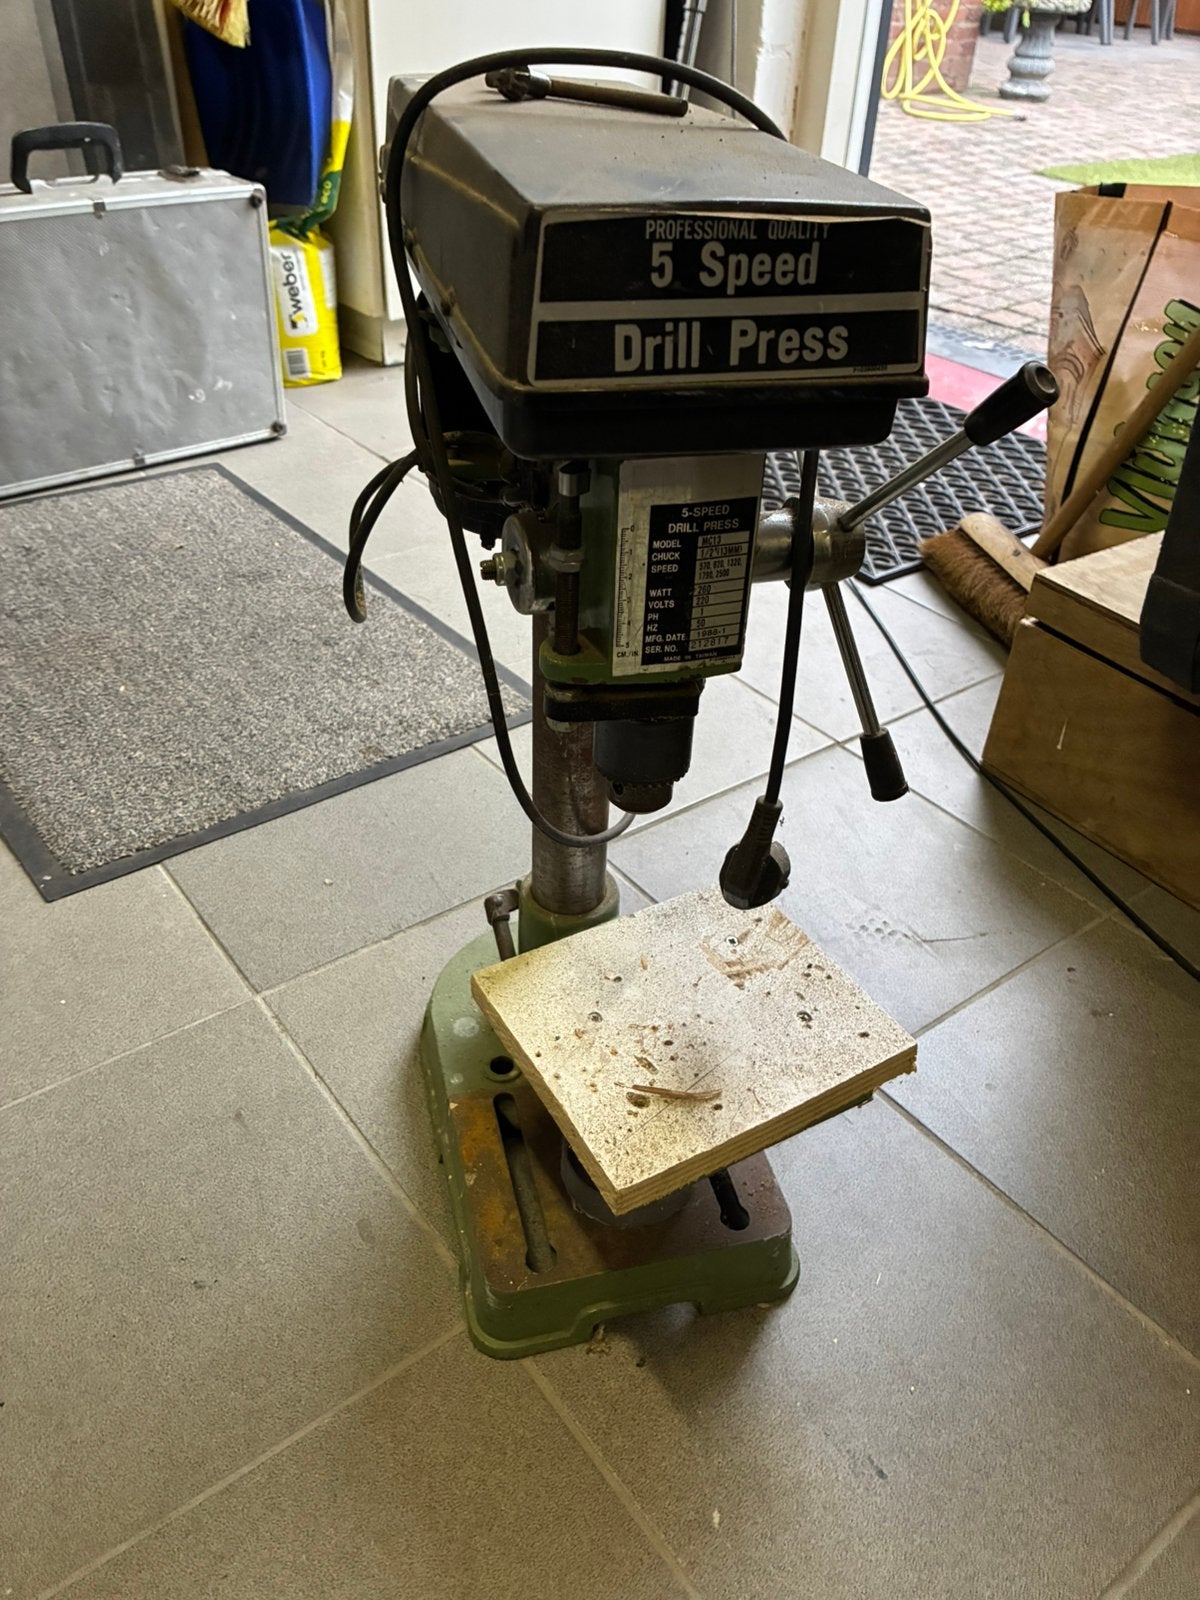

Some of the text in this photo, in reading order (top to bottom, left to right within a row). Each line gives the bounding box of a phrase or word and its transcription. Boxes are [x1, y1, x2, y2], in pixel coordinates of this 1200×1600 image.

[645, 218, 831, 241] PROFESSIONAL QUALITY
[651, 240, 821, 295] 5 Speed
[281, 252, 303, 315] weber
[614, 318, 849, 373] Drill Press
[681, 504, 730, 518] 5-SPEED
[668, 518, 740, 534] DRILL PRESS
[652, 540, 682, 549] MODEL
[701, 535, 722, 546] MC13
[651, 552, 681, 561] CHUCK
[651, 564, 679, 573] SPEED
[649, 588, 673, 597] WATT
[648, 600, 675, 609] VOLTS
[647, 613, 659, 621] PH
[646, 624, 658, 632] HZ
[666, 633, 686, 642] DATE
